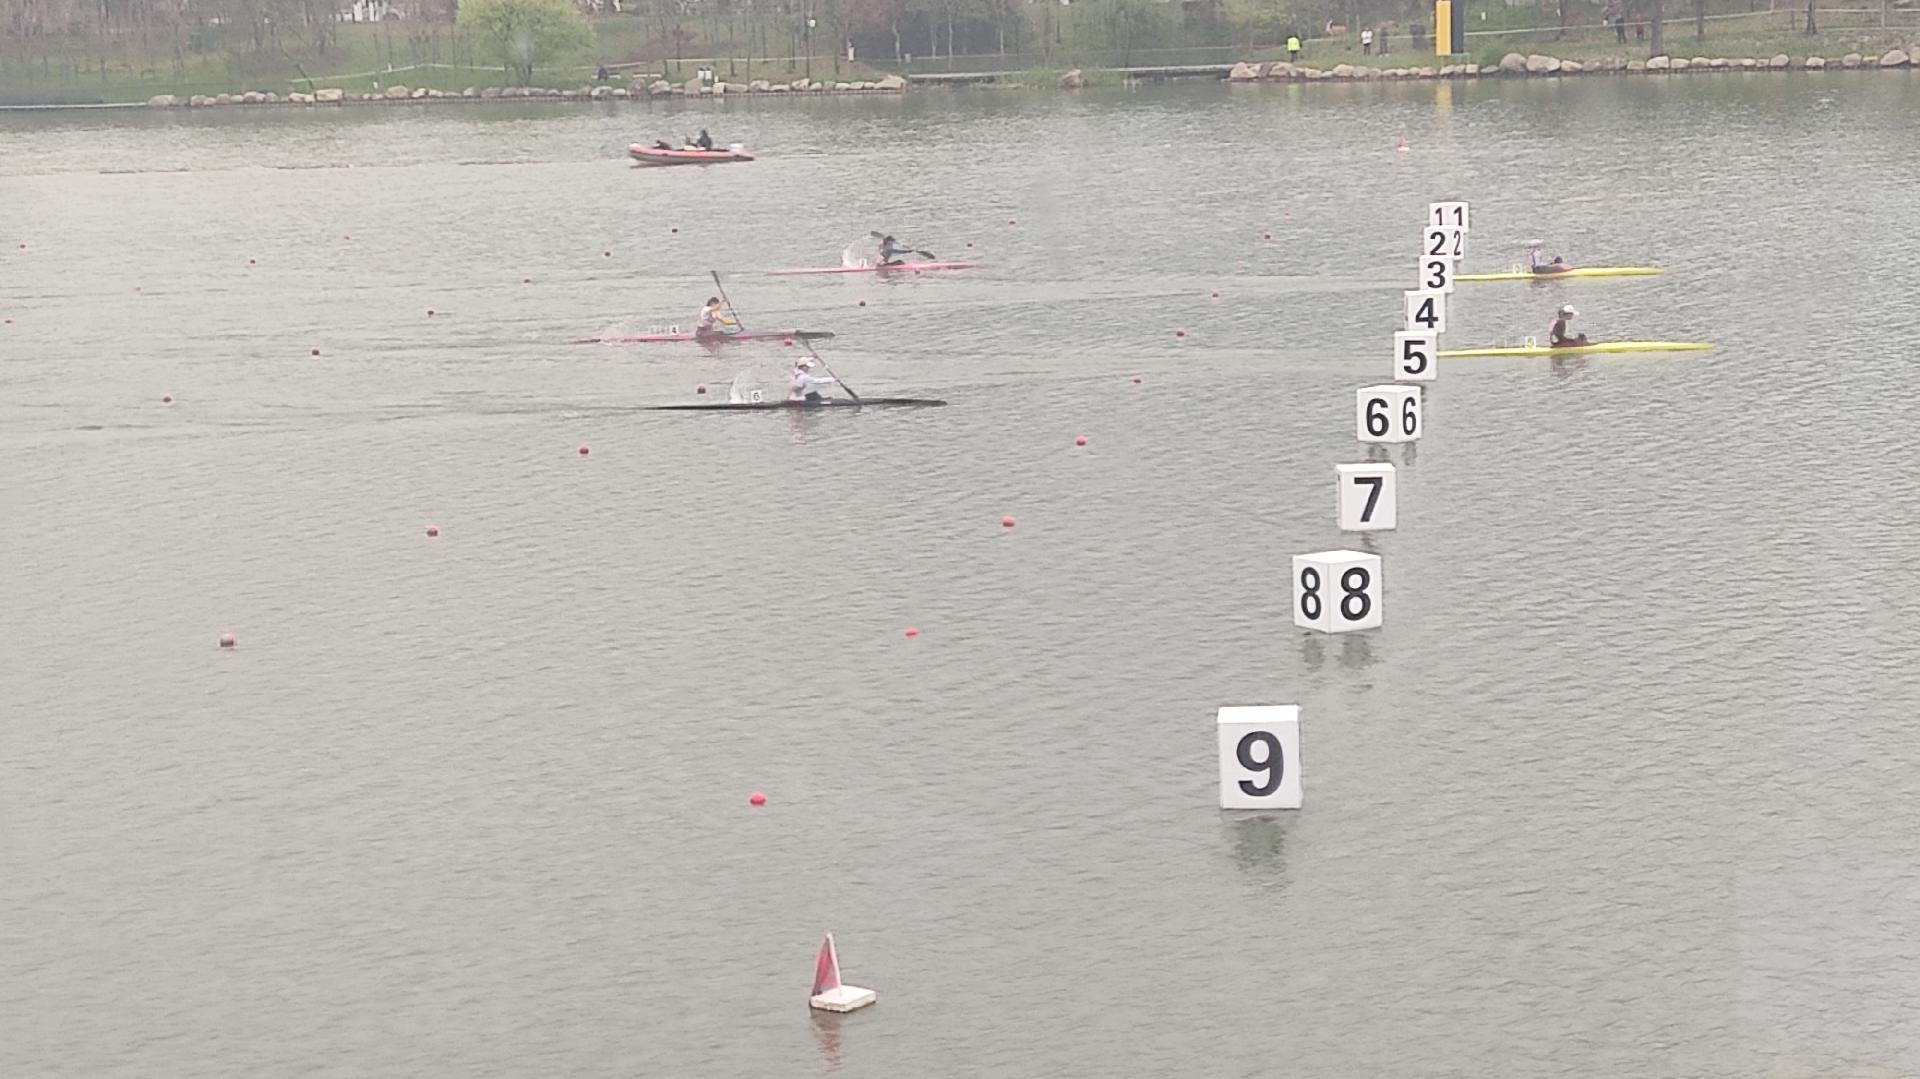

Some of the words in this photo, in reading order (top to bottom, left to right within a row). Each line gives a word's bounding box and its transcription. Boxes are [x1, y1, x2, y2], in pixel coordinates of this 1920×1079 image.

[1453, 206, 1463, 226] 1
[1429, 231, 1446, 256] 2
[1453, 230, 1462, 256] 2
[1427, 261, 1446, 289] 3
[1415, 297, 1439, 329] 4
[1403, 339, 1427, 375] 5
[1366, 398, 1390, 437] 6
[1402, 396, 1417, 436] 6
[1353, 476, 1383, 523] 7
[1300, 566, 1322, 621] 8
[1340, 566, 1371, 621] 8
[1236, 730, 1284, 797] 9
